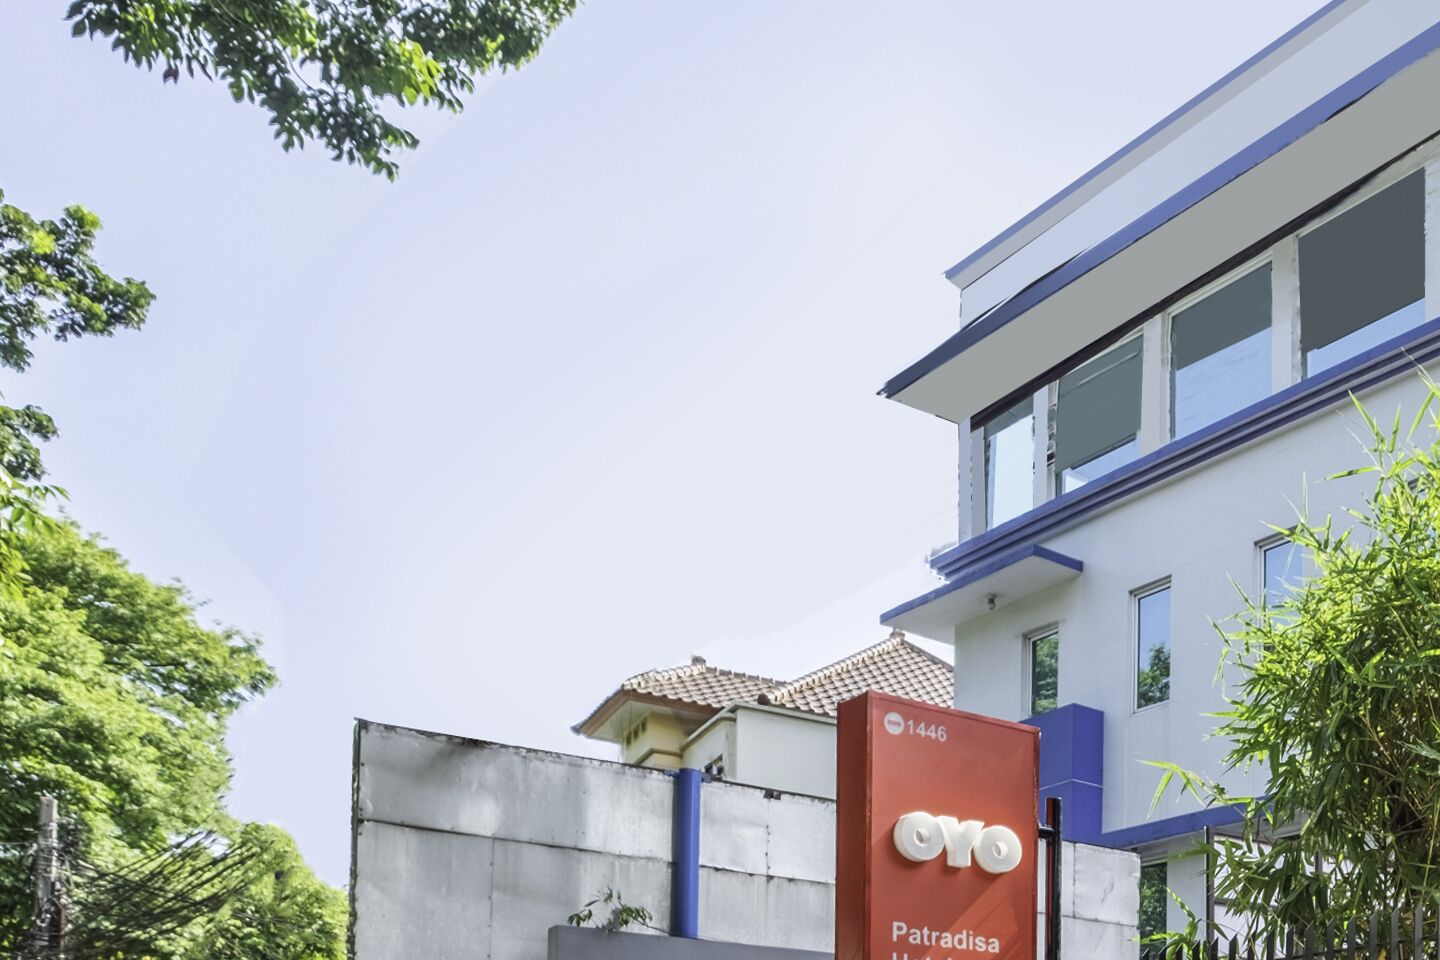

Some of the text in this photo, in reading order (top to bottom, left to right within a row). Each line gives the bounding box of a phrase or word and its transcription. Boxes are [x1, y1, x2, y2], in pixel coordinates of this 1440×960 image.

[906, 719, 948, 742] 1446
[893, 811, 1023, 874] OYO
[891, 921, 1001, 954] Patradisa
